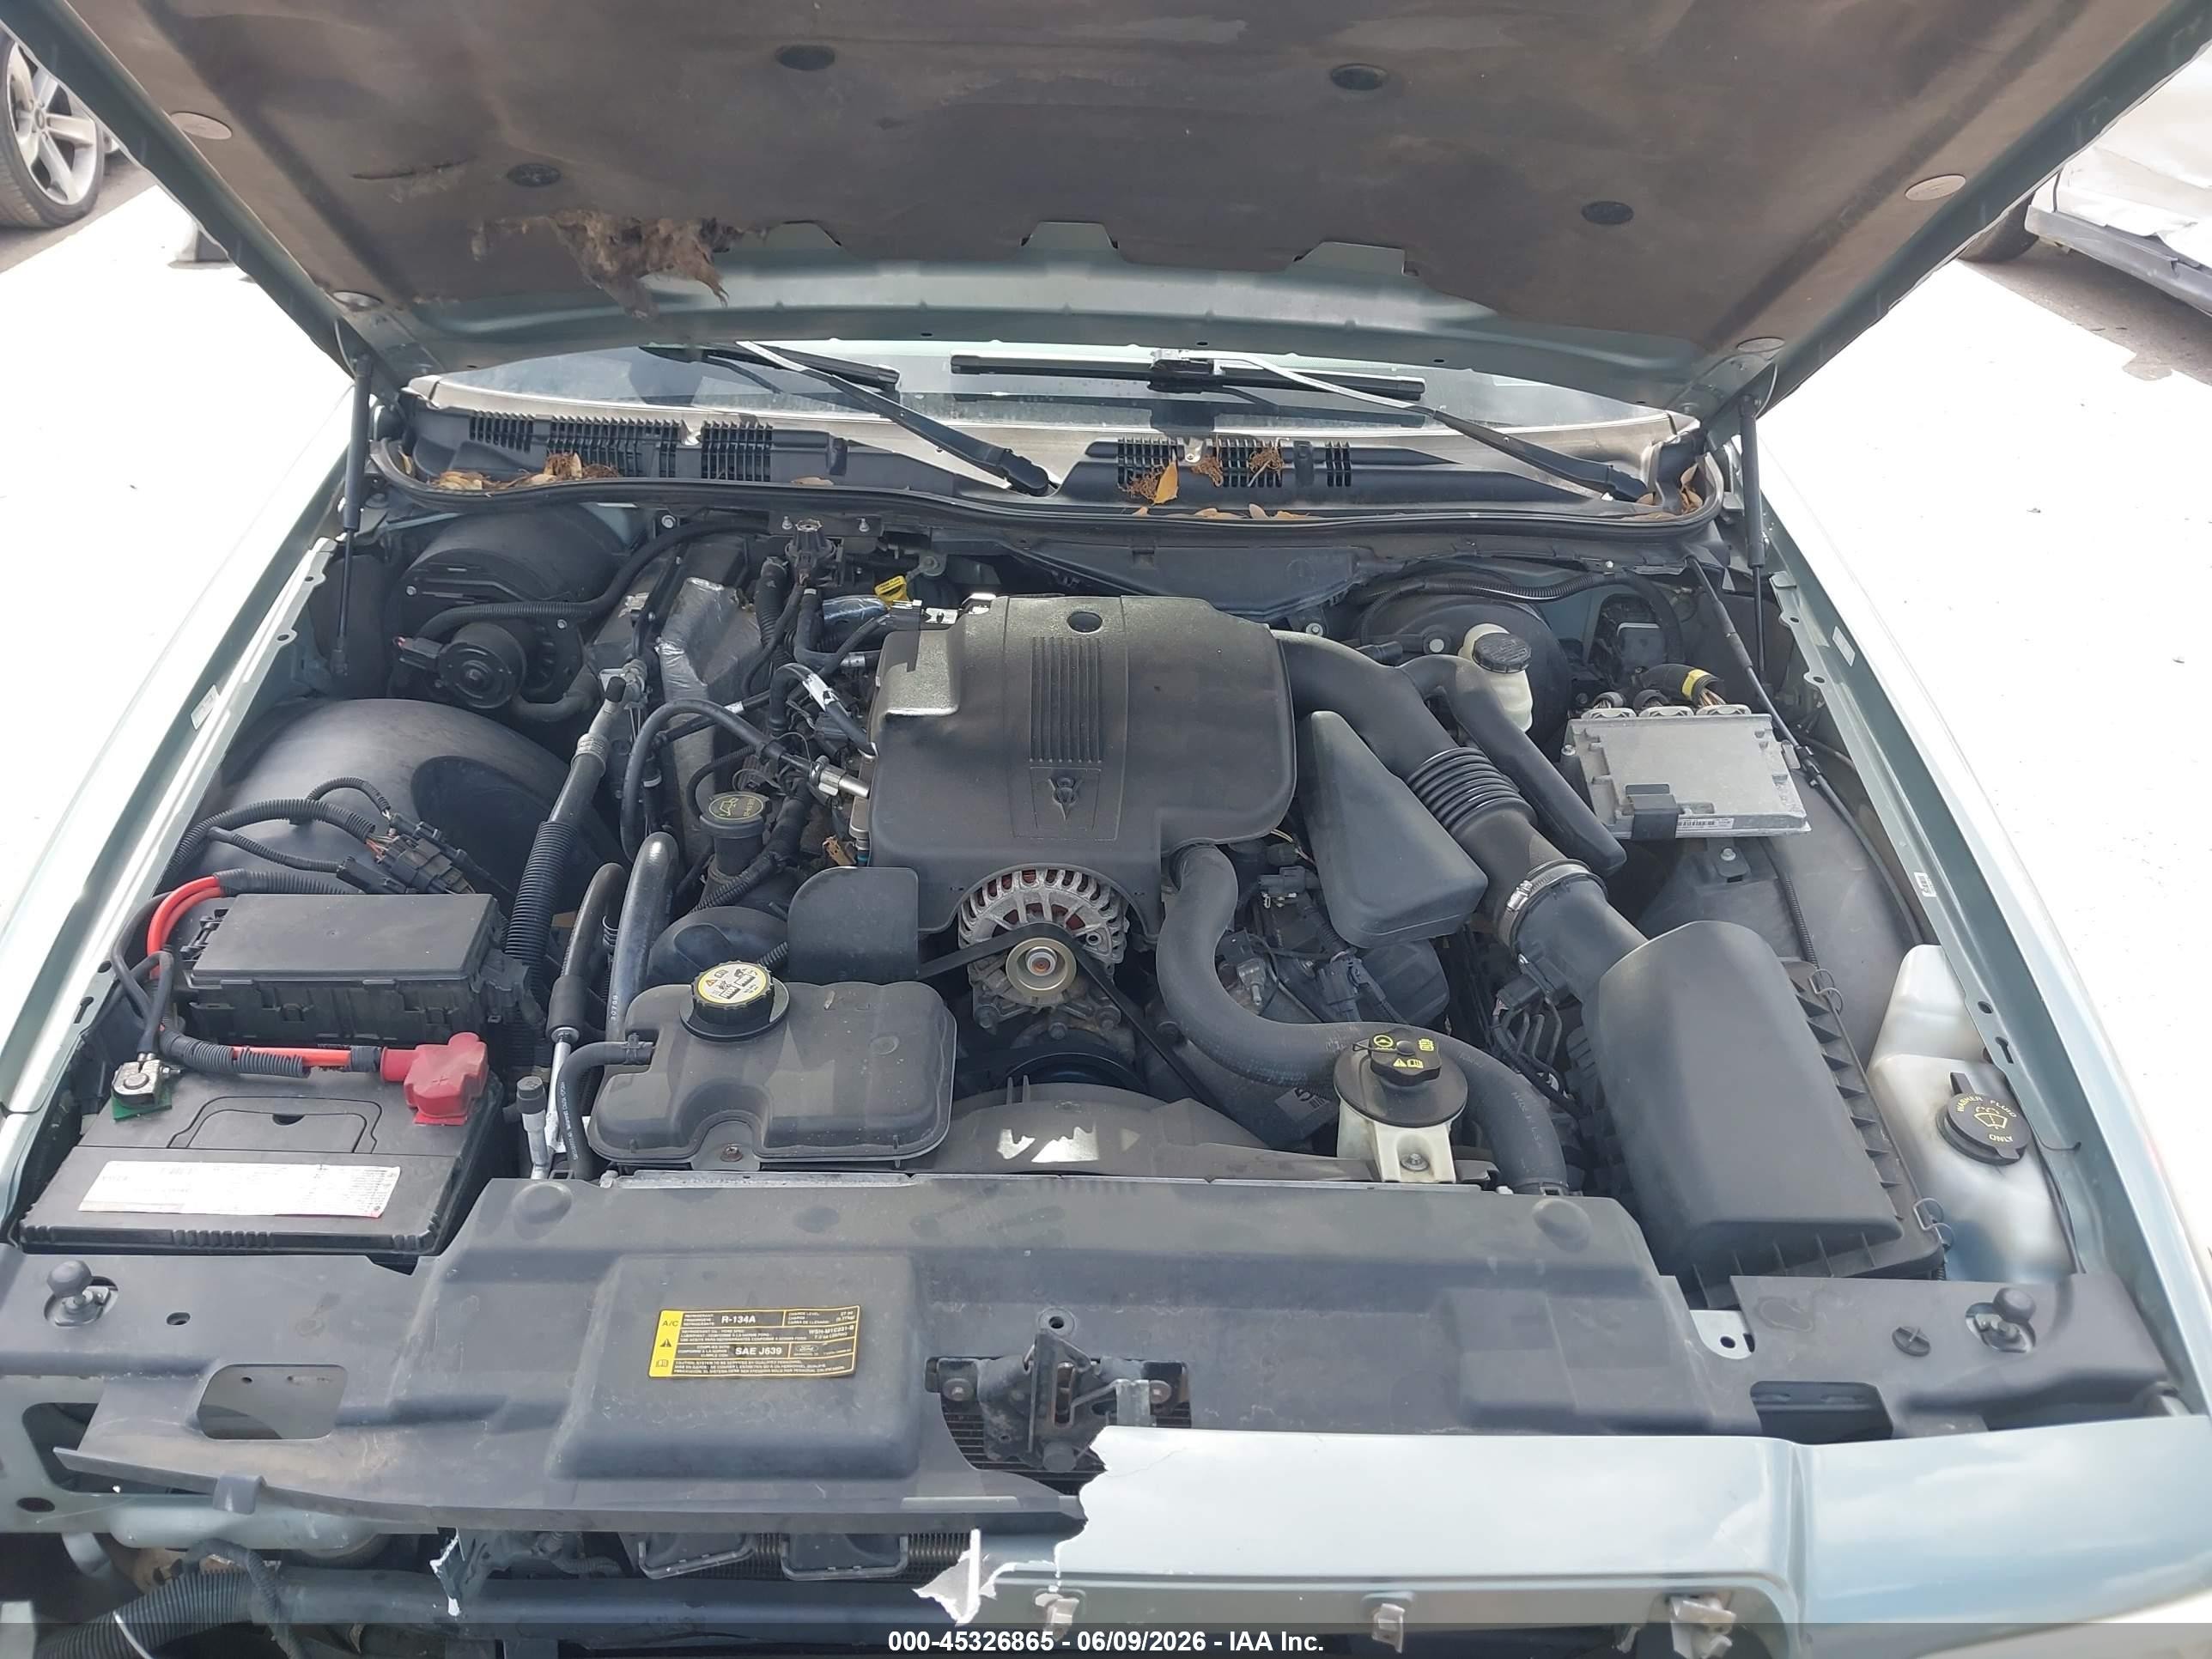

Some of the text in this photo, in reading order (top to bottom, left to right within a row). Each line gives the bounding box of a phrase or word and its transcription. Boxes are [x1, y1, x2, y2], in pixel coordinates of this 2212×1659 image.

[1957, 1096, 2017, 1117] WASHER FLUID
[721, 1316, 757, 1324] R-134A
[735, 1346, 757, 1355] SAE
[758, 1346, 782, 1355] J639
